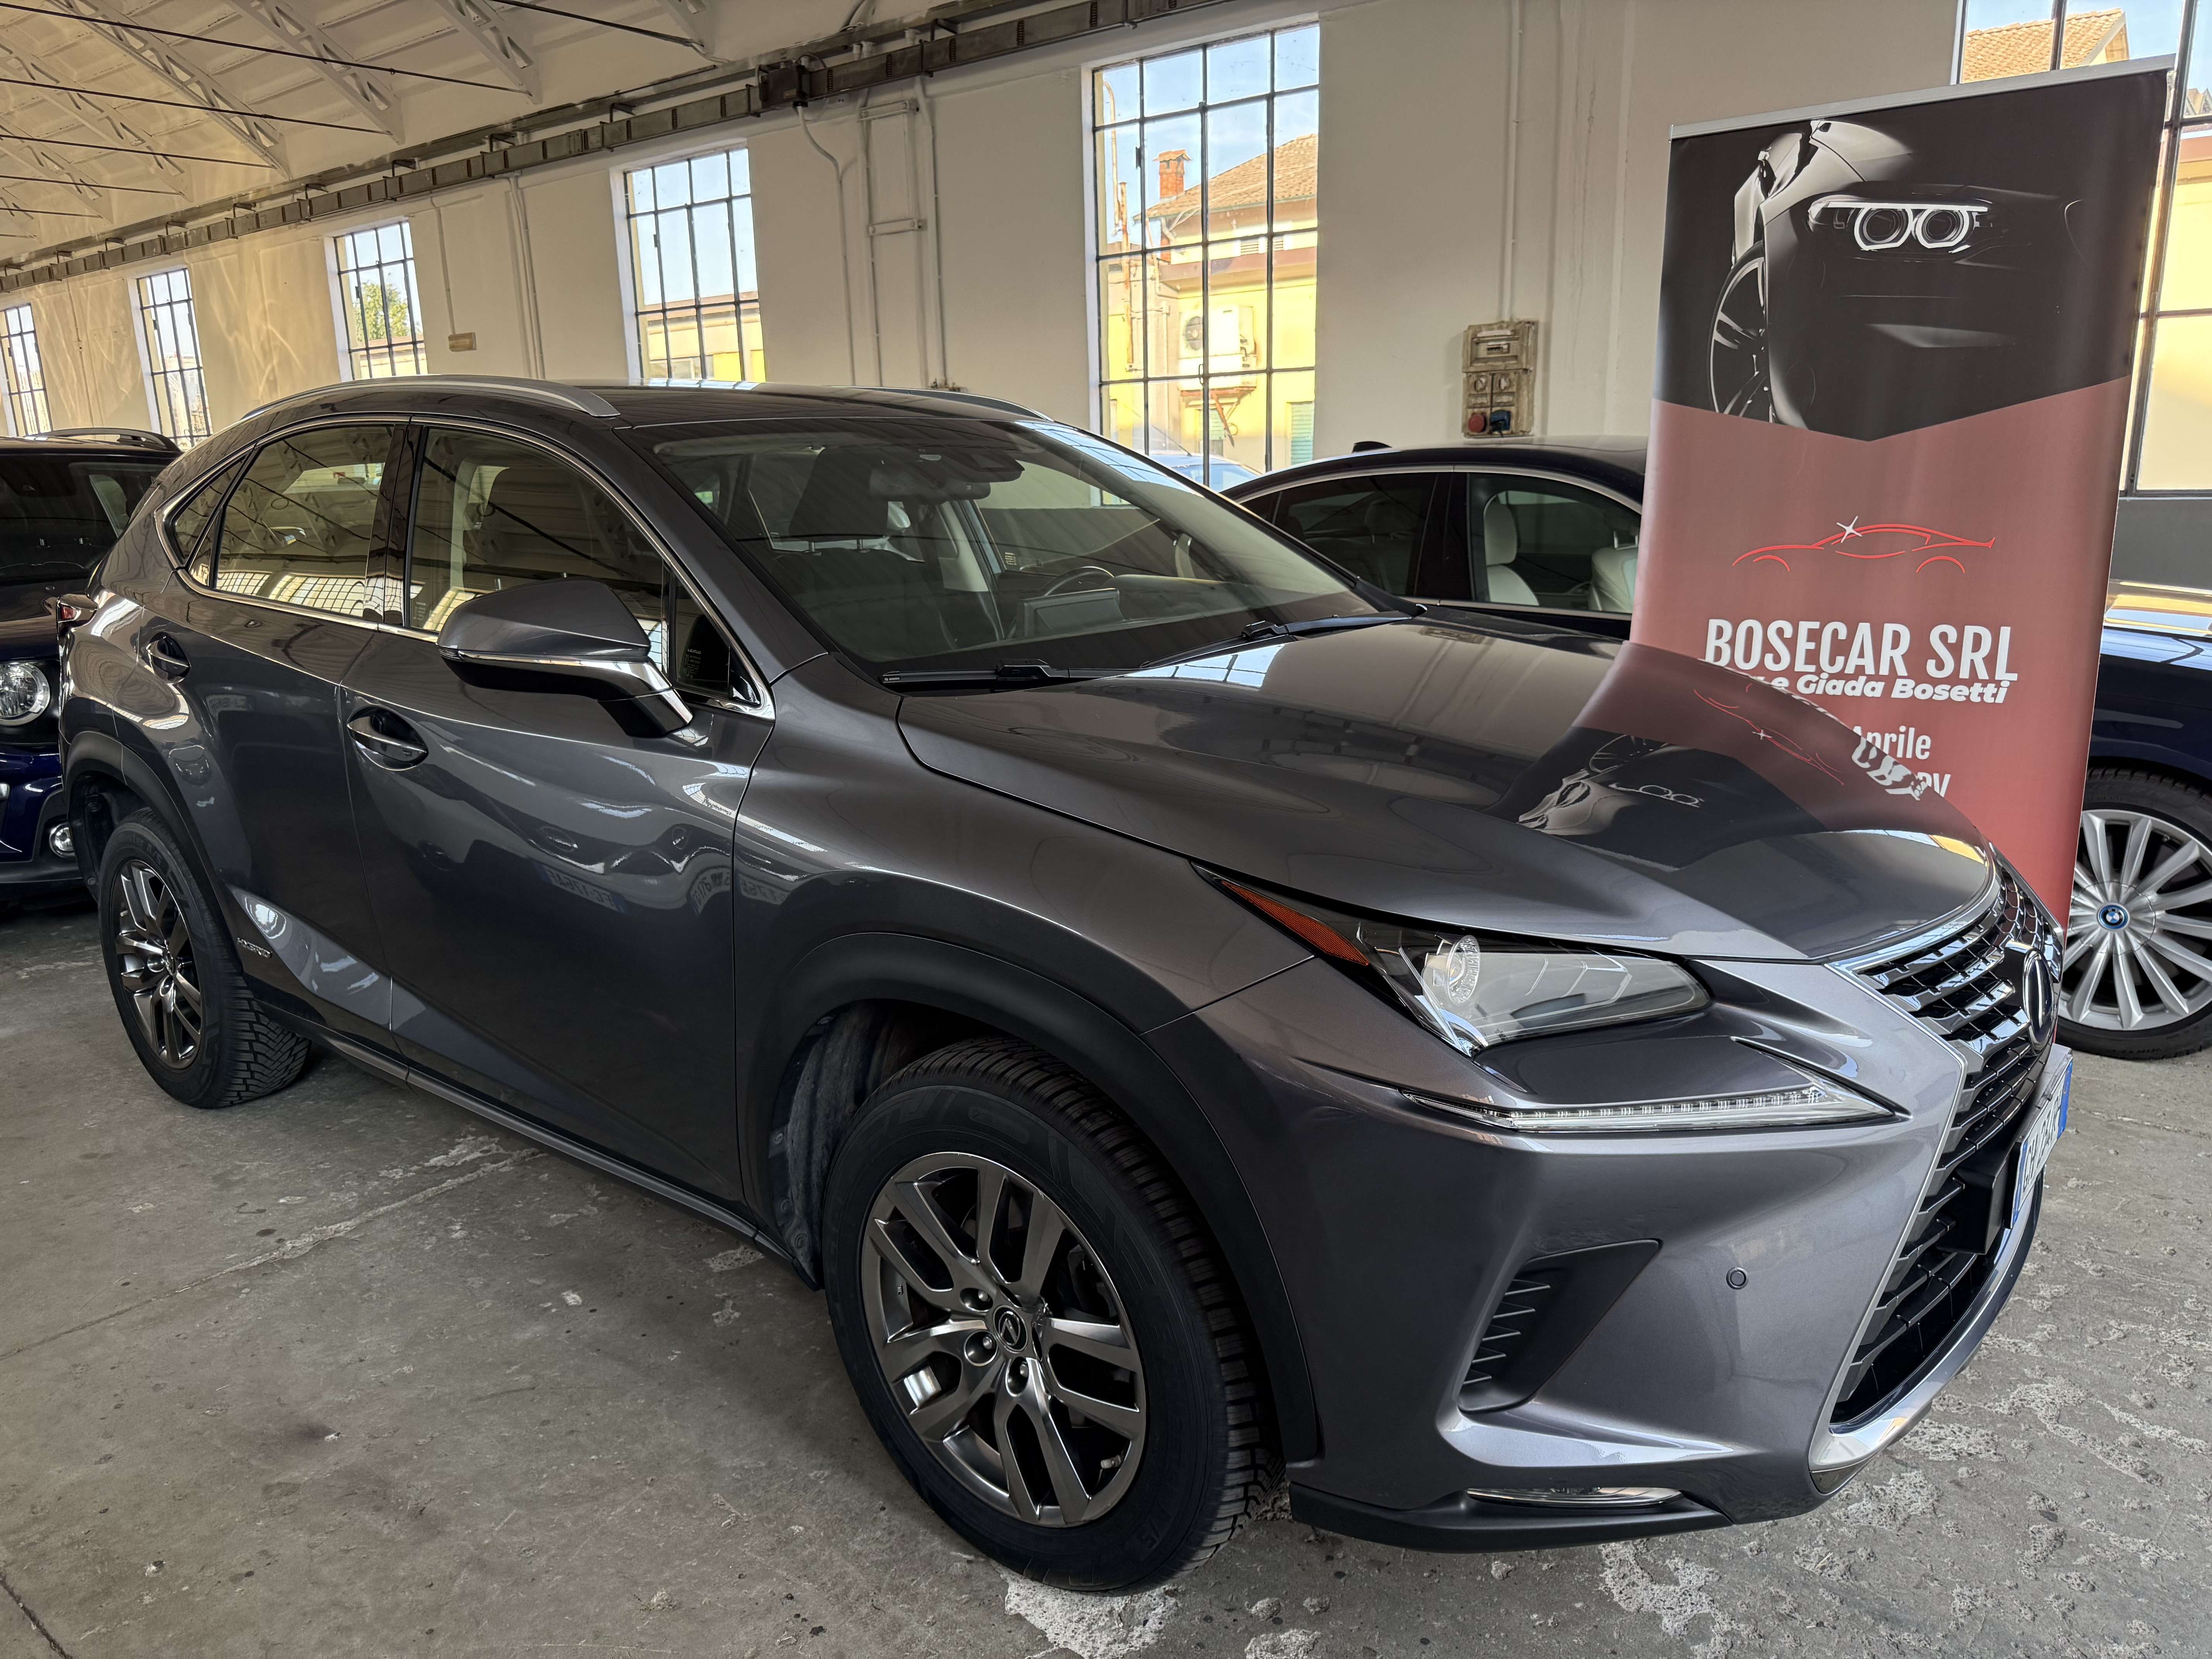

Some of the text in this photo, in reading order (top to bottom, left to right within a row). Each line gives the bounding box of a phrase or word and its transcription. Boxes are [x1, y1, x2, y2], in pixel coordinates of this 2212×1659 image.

[1705, 618, 2018, 681] BOSECAR SRL
[1796, 673, 1885, 698] Giada
[1891, 678, 2010, 704] Bosetti
